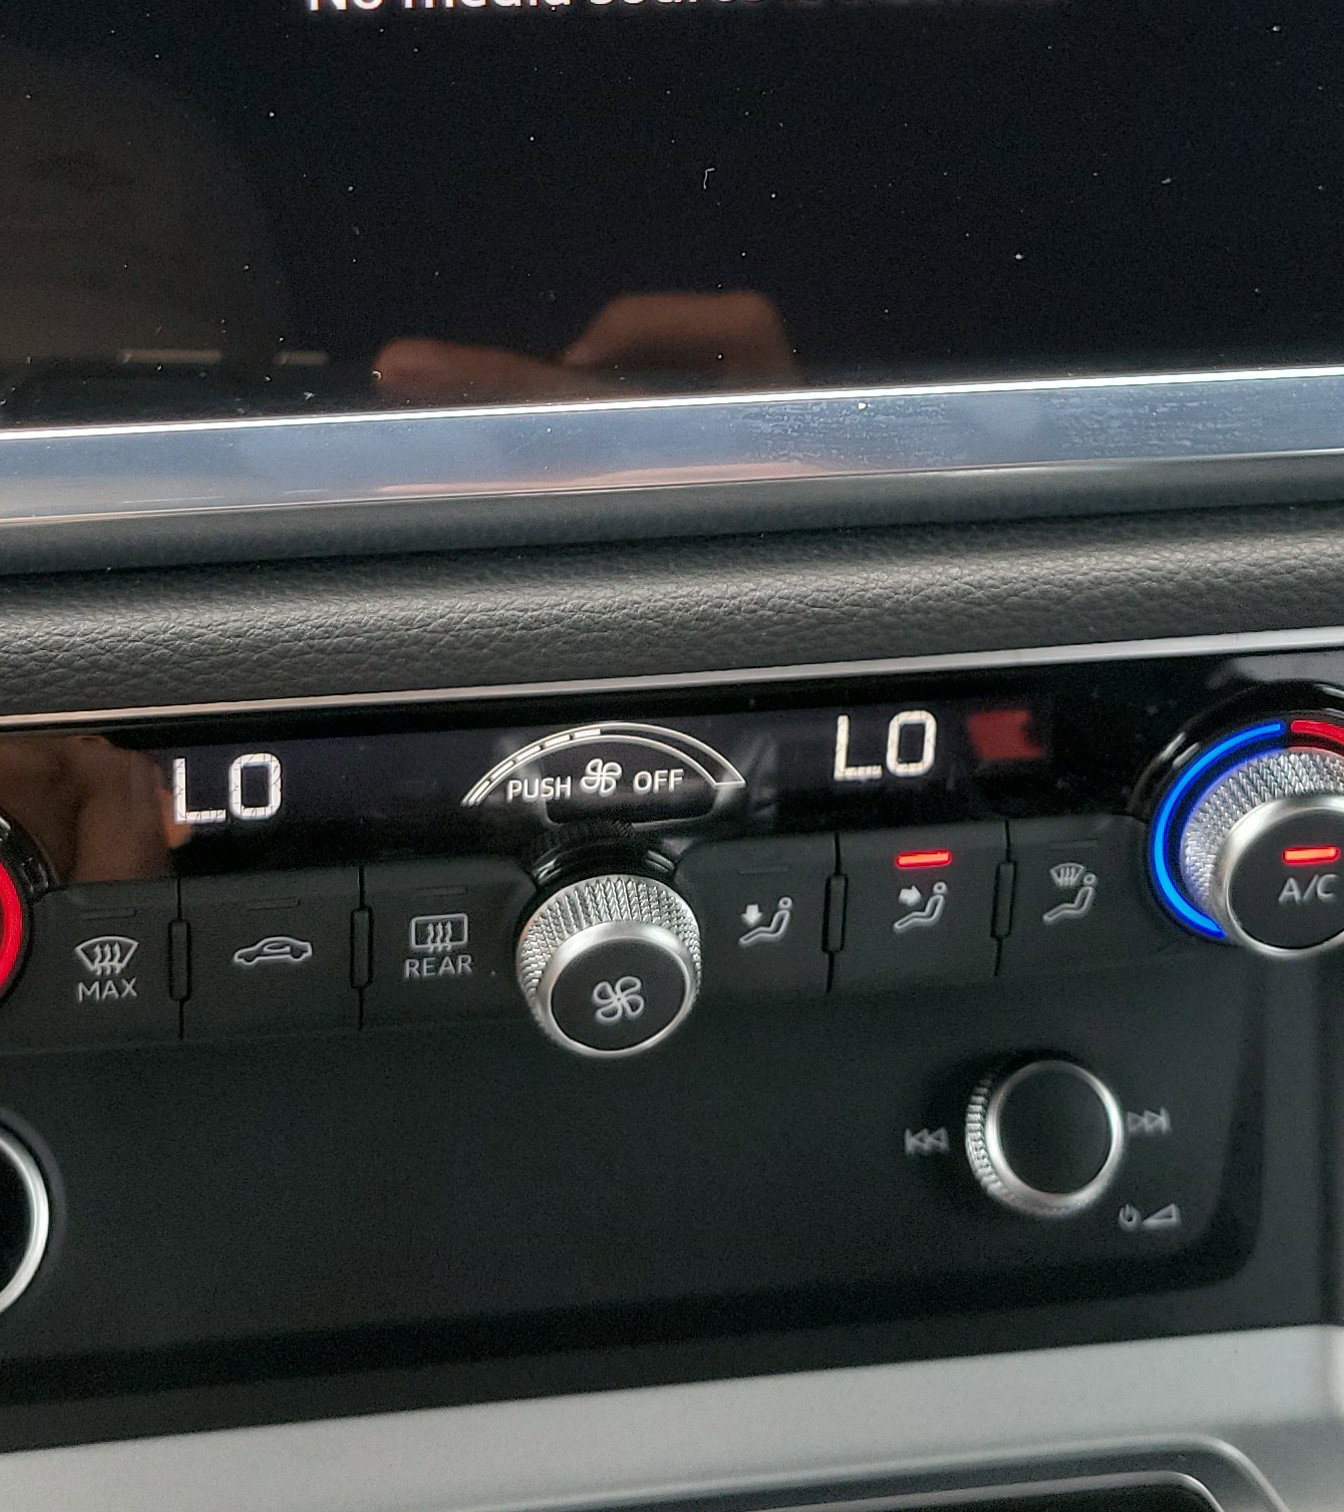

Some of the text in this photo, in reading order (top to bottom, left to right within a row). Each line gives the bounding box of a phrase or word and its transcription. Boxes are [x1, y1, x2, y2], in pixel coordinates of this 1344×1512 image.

[833, 710, 937, 781] LO
[171, 752, 283, 825] LO
[505, 766, 685, 802] PUSH OFF
[1278, 873, 1337, 903] A/C
[404, 954, 472, 979] REAR
[77, 977, 138, 1003] MAX
